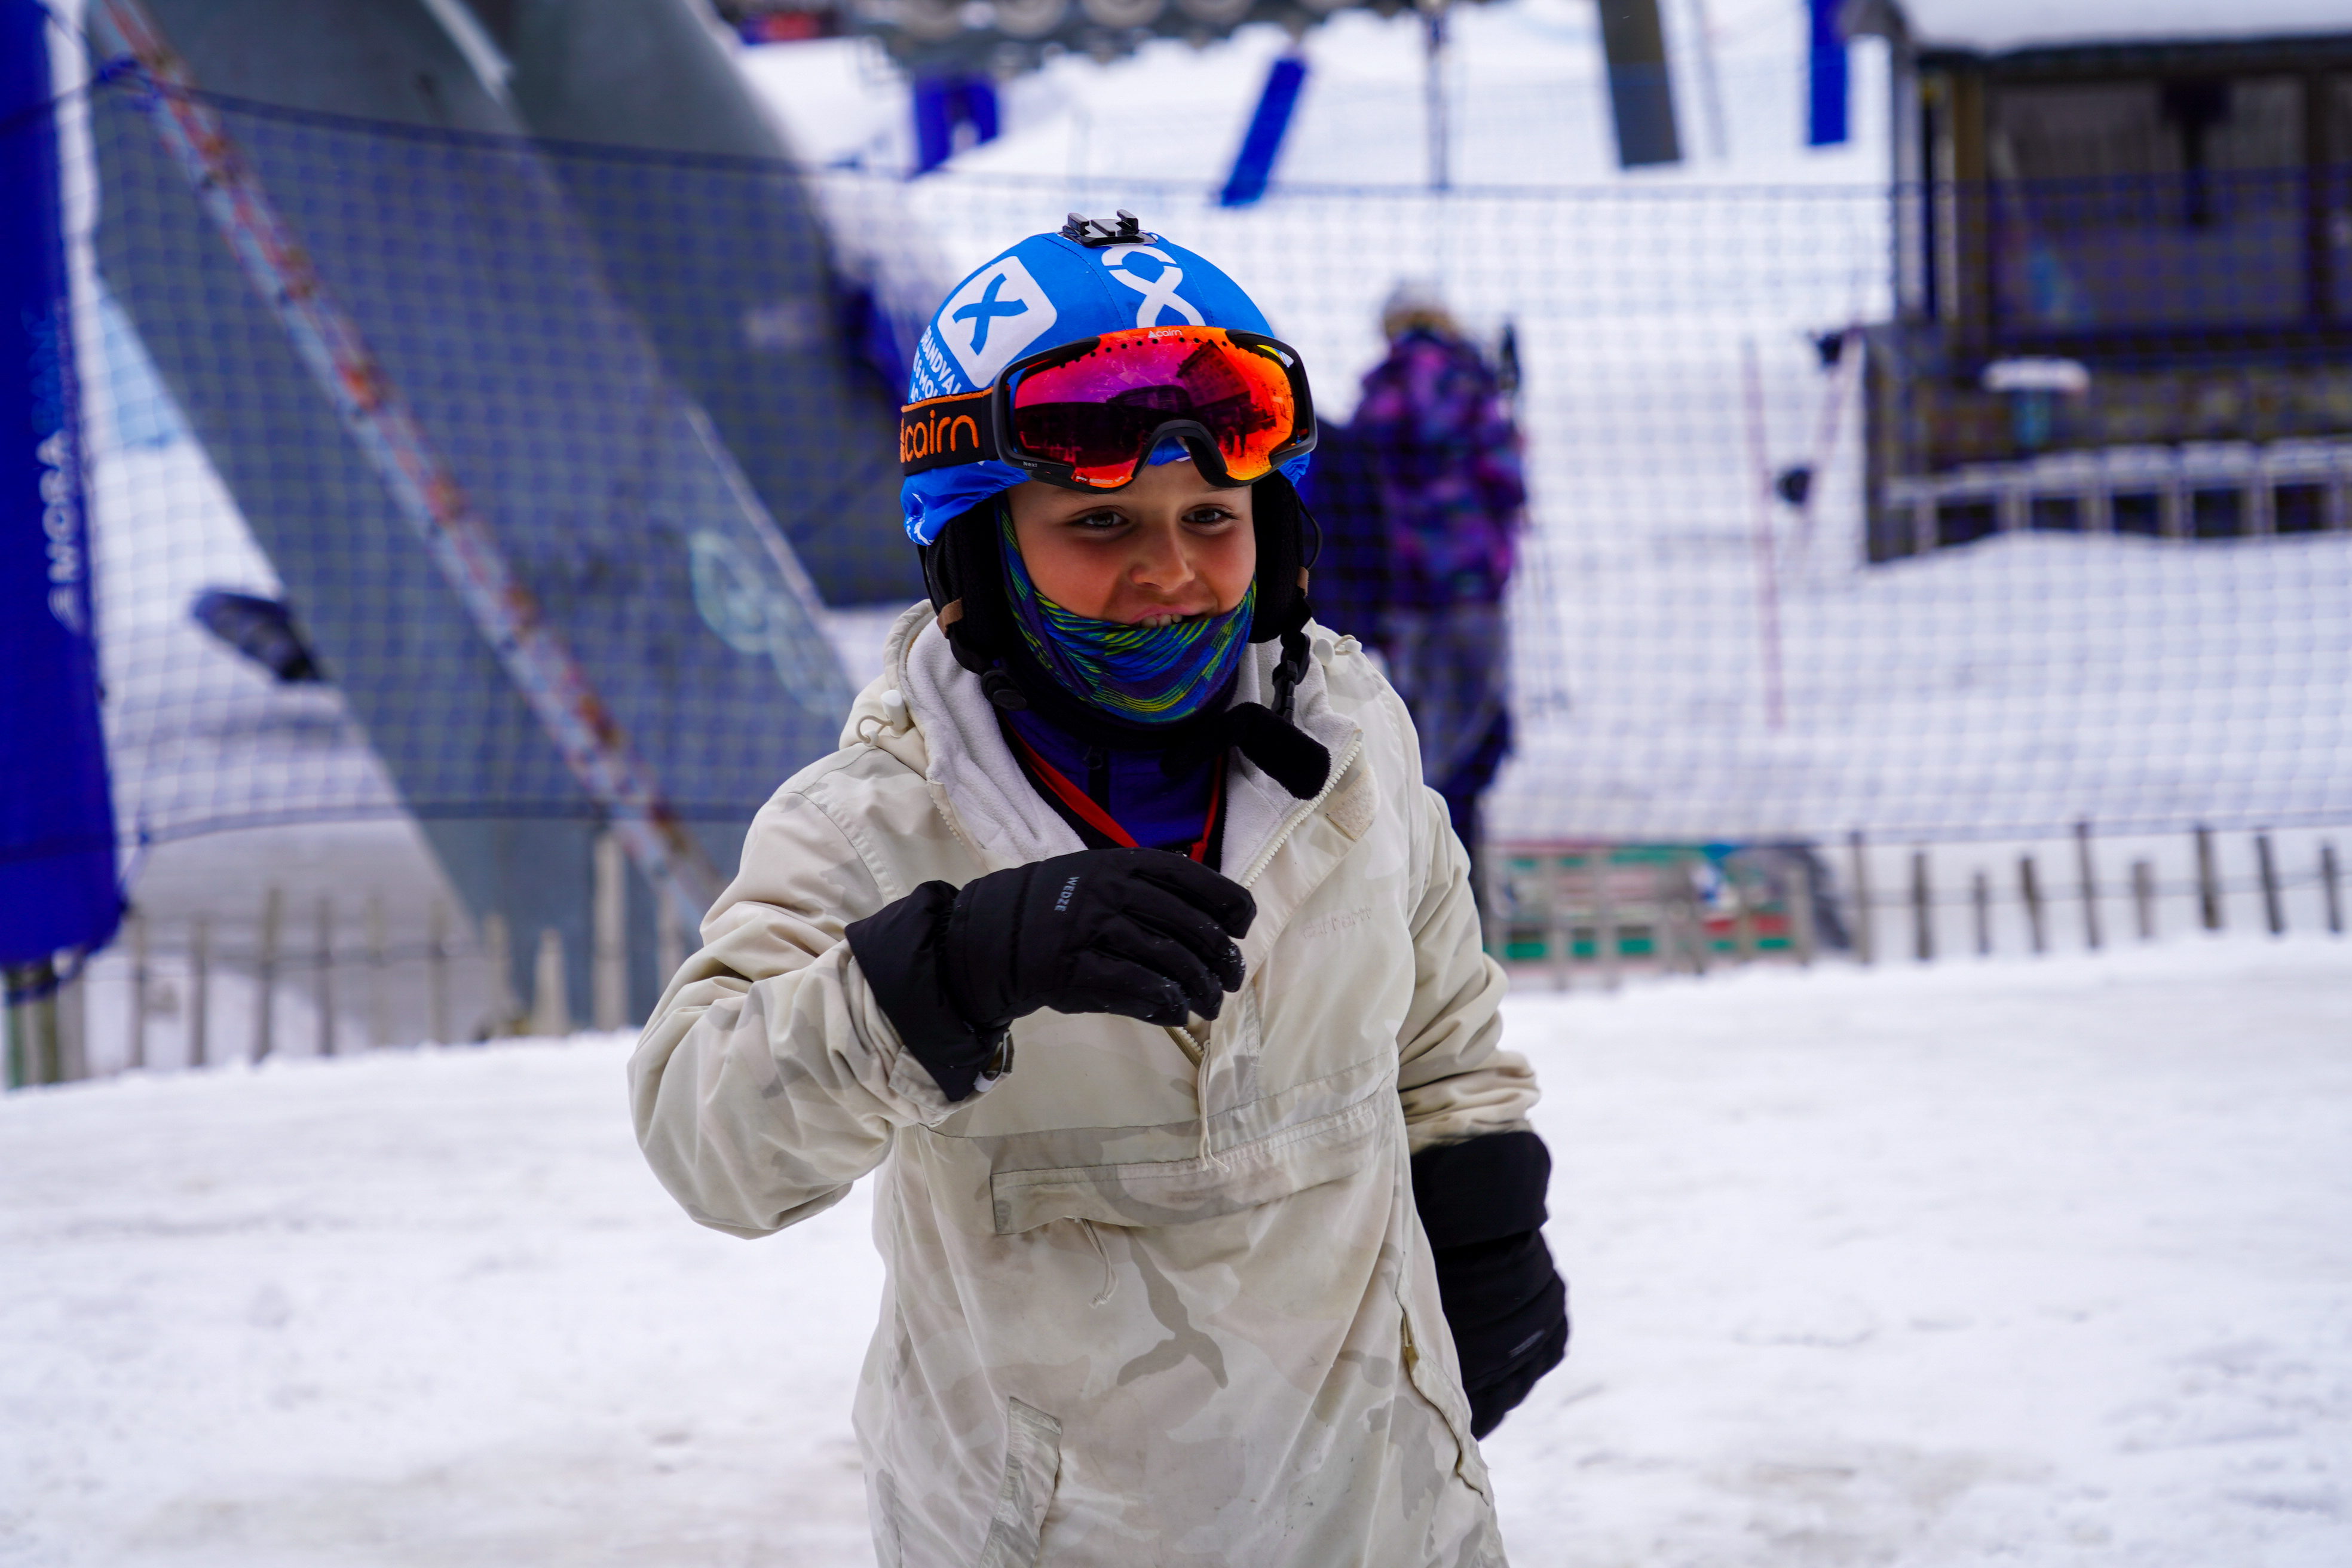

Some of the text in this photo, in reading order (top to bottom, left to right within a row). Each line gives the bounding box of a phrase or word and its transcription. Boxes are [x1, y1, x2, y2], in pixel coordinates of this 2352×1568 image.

[1156, 329, 1183, 337] cairn
[905, 409, 979, 462] cairn
[1054, 876, 1080, 912] WEDZE
